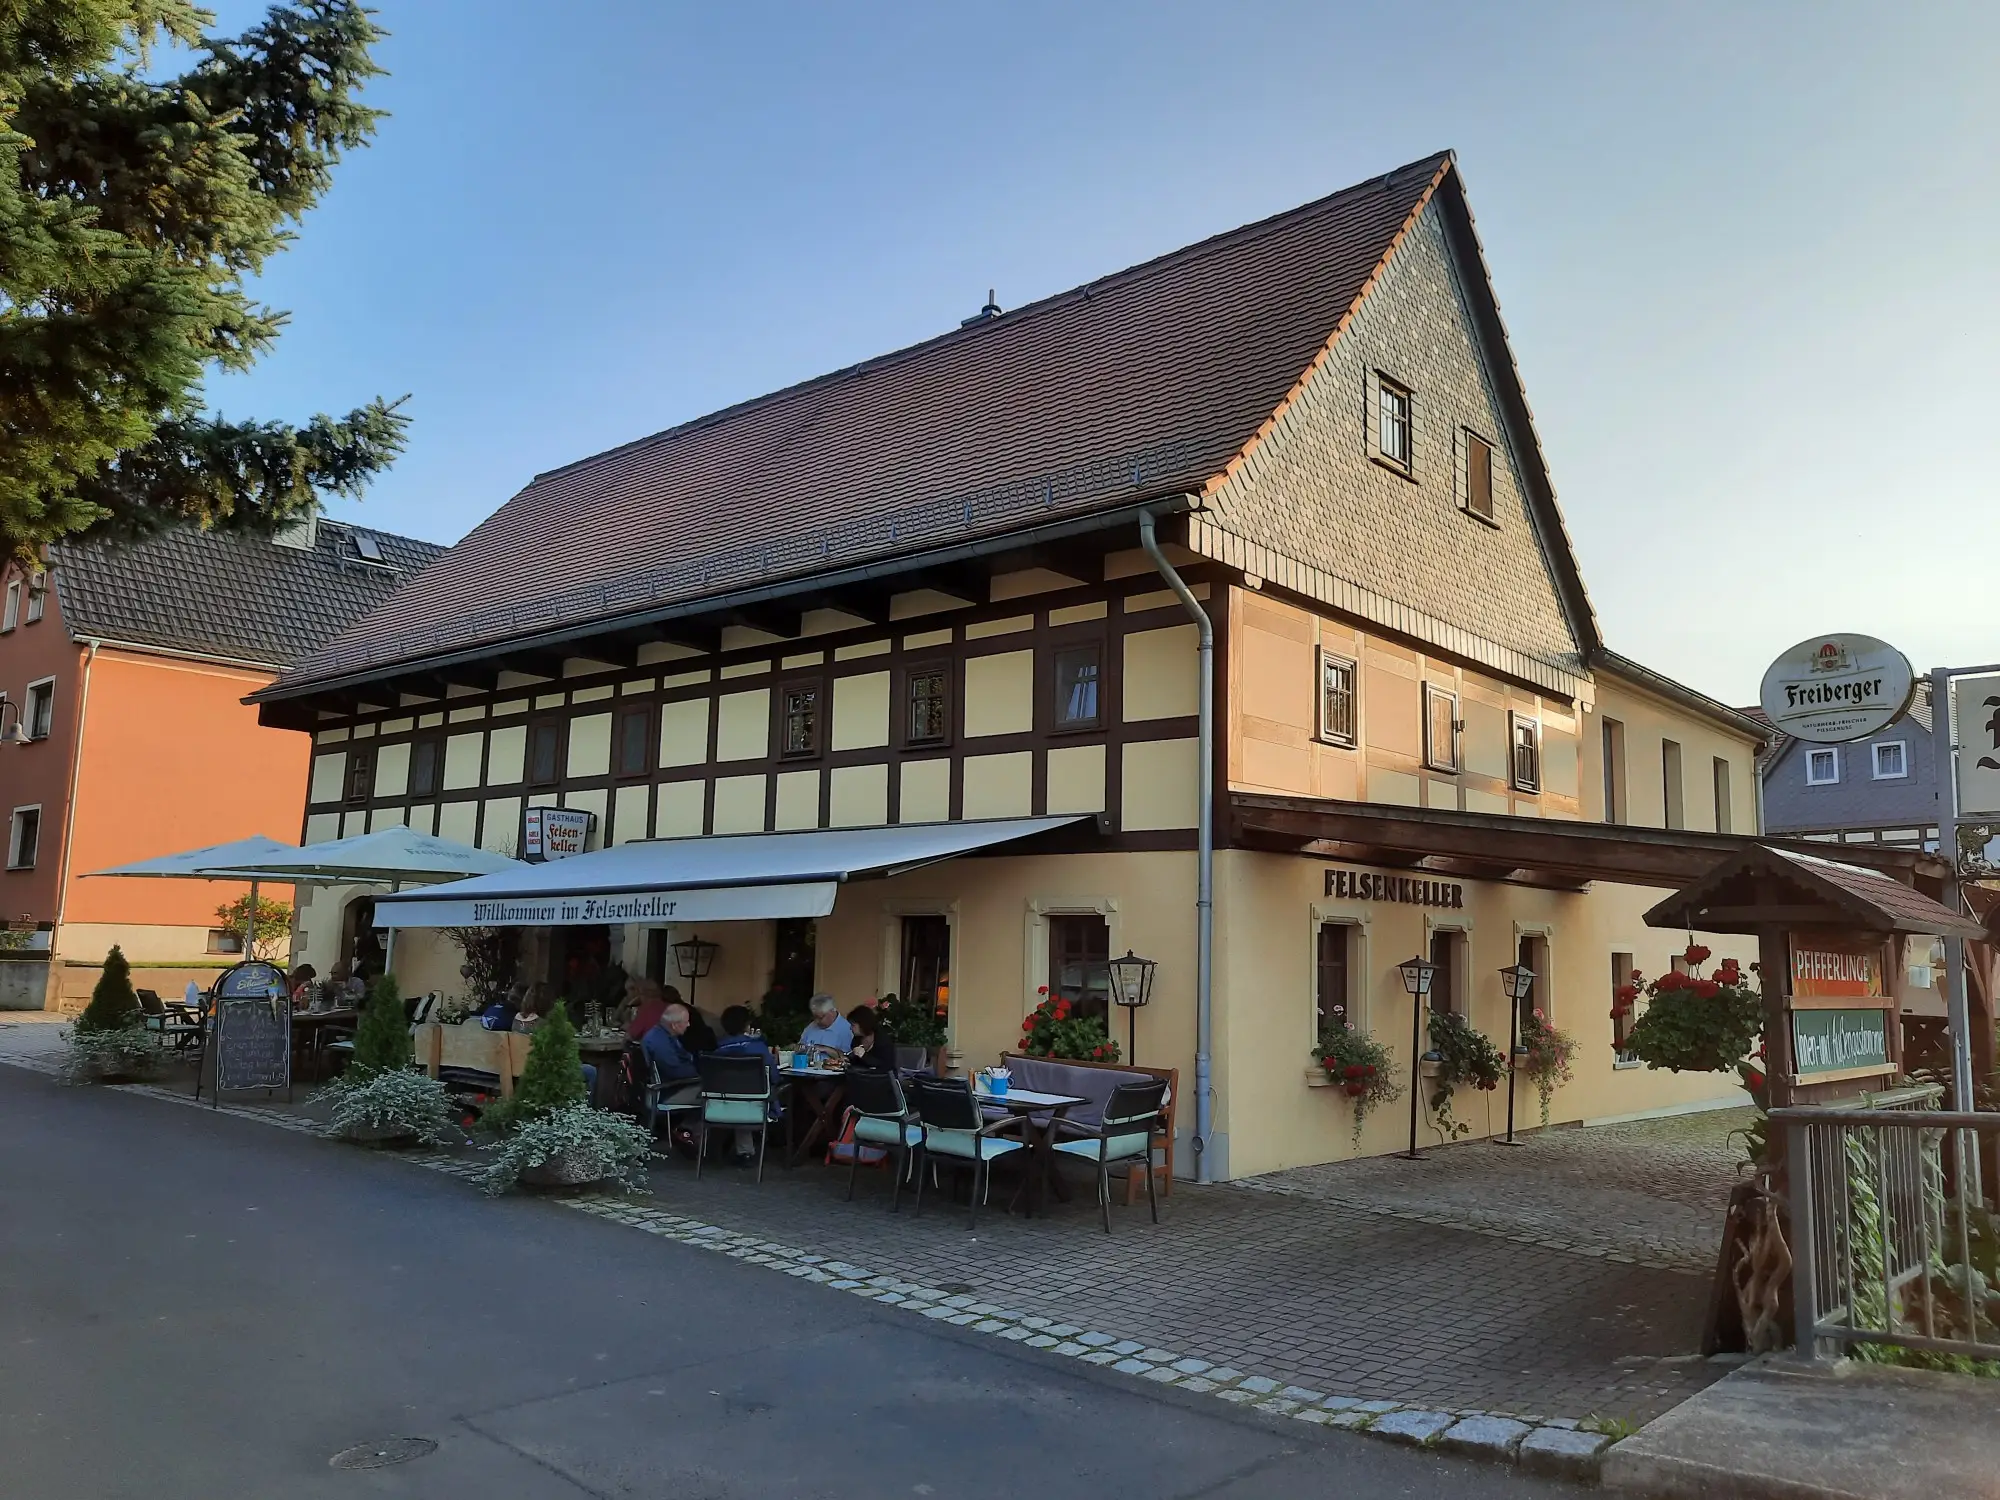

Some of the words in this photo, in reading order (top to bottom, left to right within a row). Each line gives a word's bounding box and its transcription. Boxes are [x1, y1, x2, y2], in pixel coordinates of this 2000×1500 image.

[1784, 678, 1882, 708] Freiberger
[546, 813, 584, 824] GASTHAUS
[546, 823, 583, 840] Felsen-
[550, 839, 578, 853] keller
[1324, 869, 1464, 909] FELSENKELLER
[474, 903, 555, 921] Willkommen
[561, 901, 579, 920] im
[582, 897, 677, 920] Felsenkeller
[1796, 950, 1869, 982] PFIFFERLINGE
